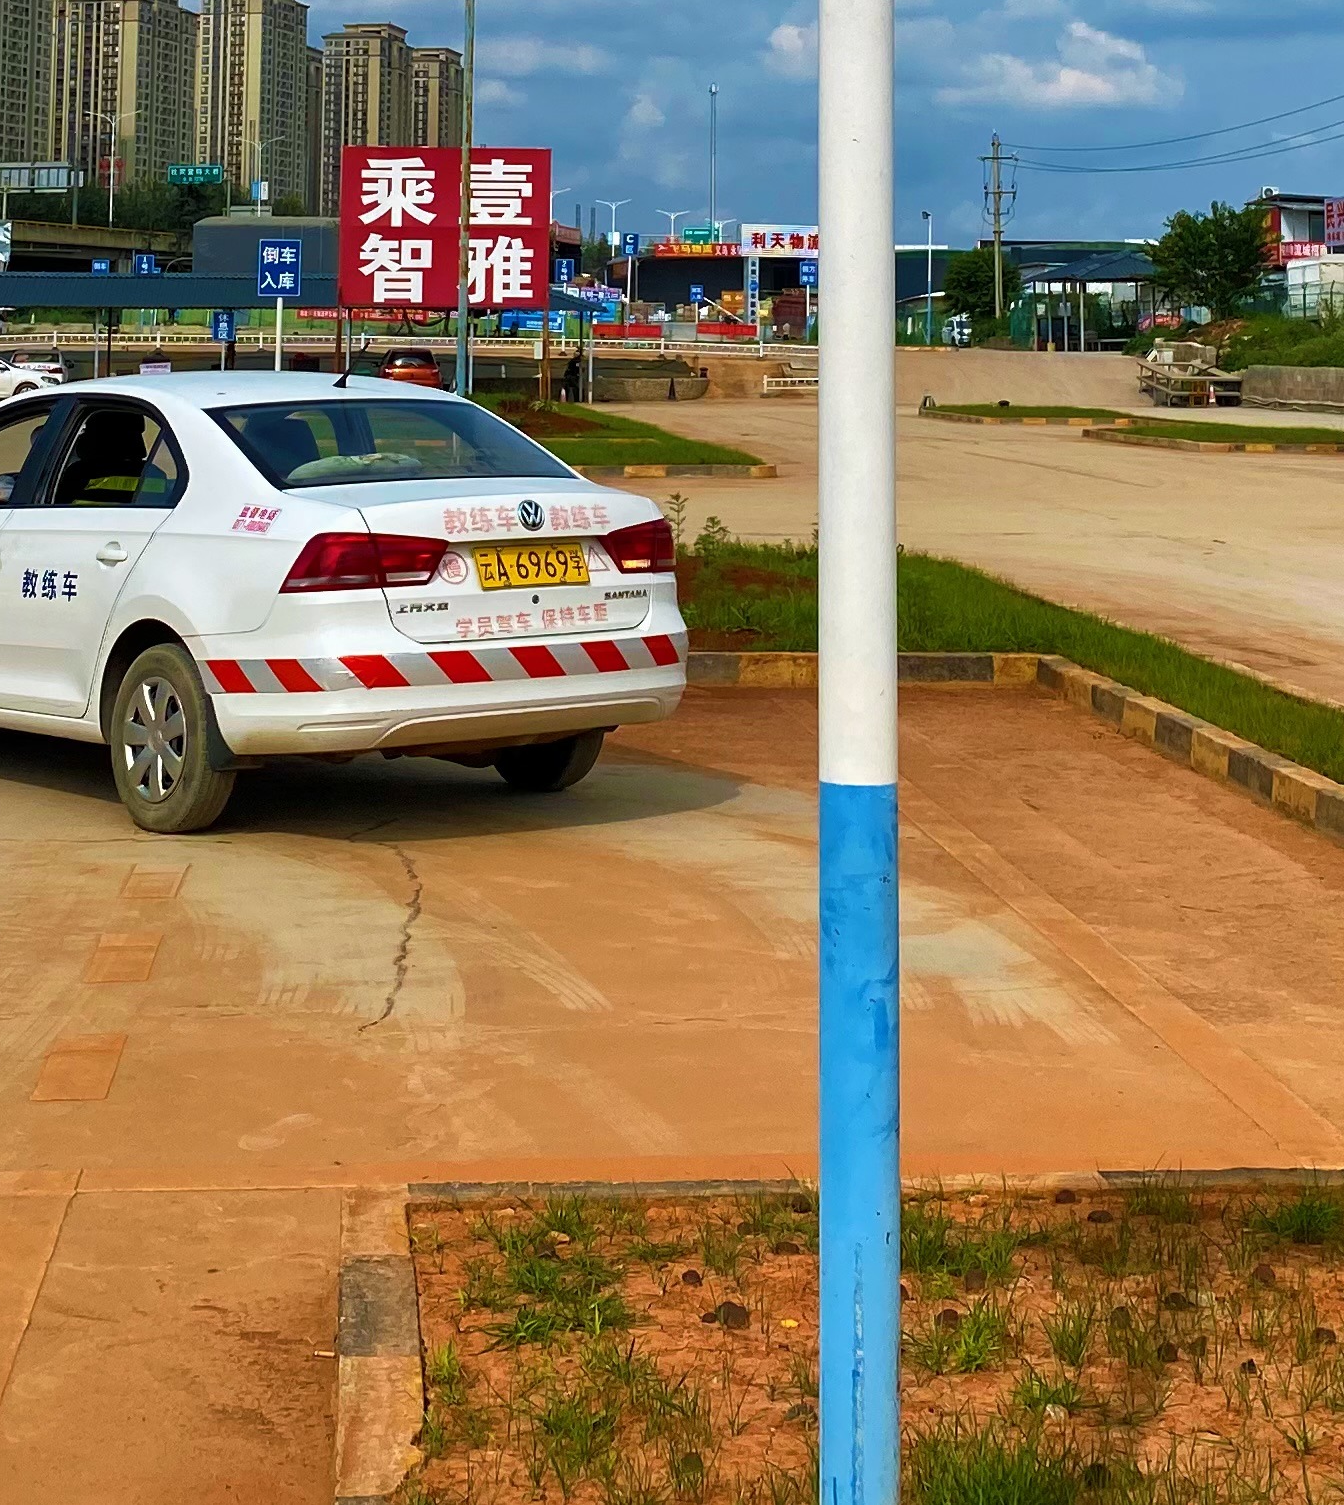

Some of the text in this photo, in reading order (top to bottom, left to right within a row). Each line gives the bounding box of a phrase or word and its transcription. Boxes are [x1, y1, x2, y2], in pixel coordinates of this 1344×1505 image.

[626, 234, 635, 243] C
[262, 246, 297, 265] 倒车
[260, 271, 295, 290] 入库
[217, 313, 229, 340] 休息区
[443, 506, 518, 534] 教练车
[549, 504, 611, 530] 教练车
[22, 568, 78, 602] 教练车
[604, 589, 648, 600] SANTANA
[456, 602, 609, 638] 学员驾车 保持车距
